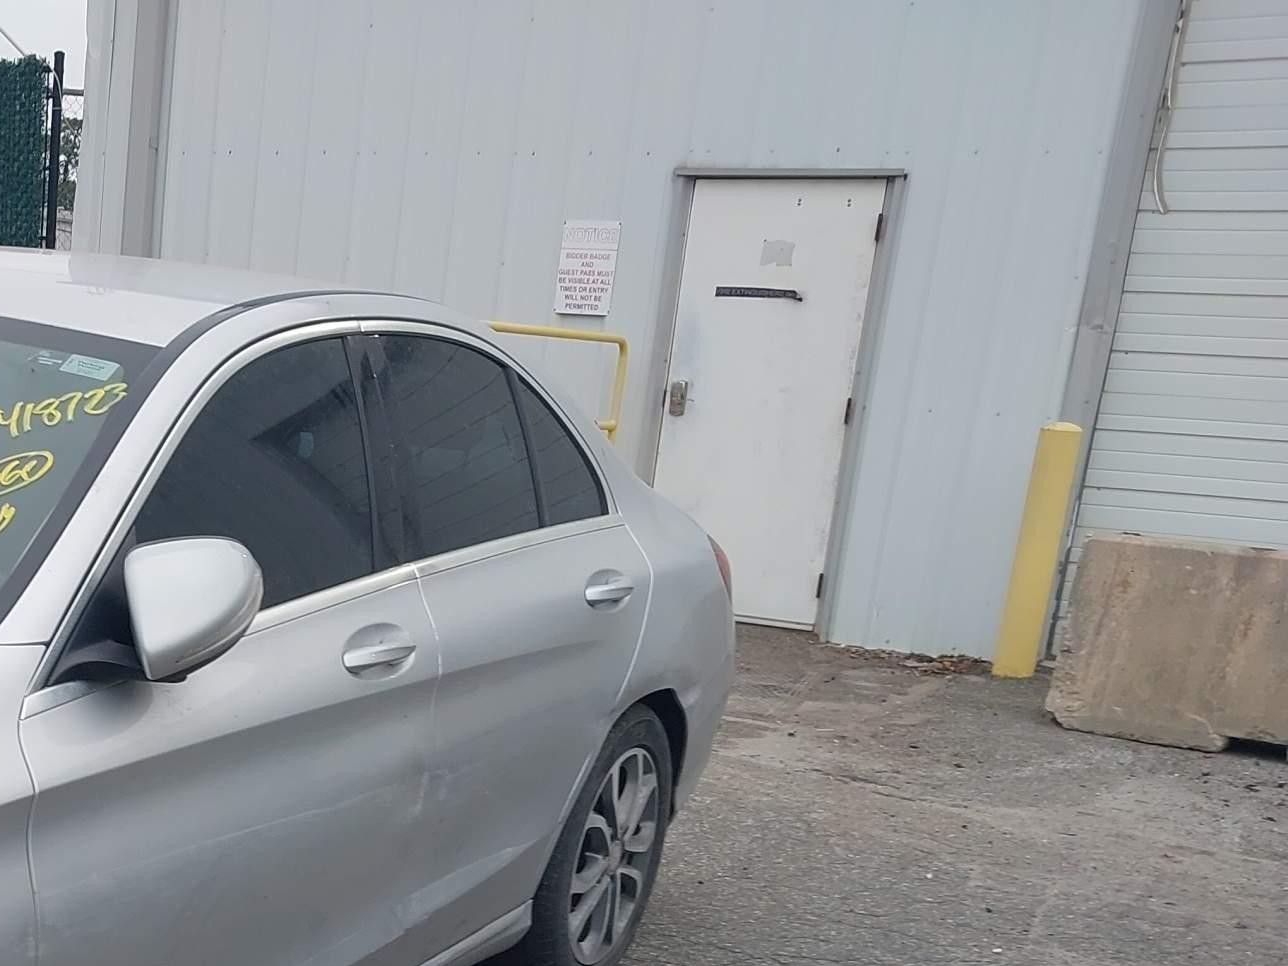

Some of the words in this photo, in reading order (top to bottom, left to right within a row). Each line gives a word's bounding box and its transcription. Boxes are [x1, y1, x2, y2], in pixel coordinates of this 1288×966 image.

[568, 277, 590, 285] VISIBLE
[600, 278, 612, 286] ALL
[560, 285, 577, 293] TIMES
[565, 303, 599, 311] PERMITTED
